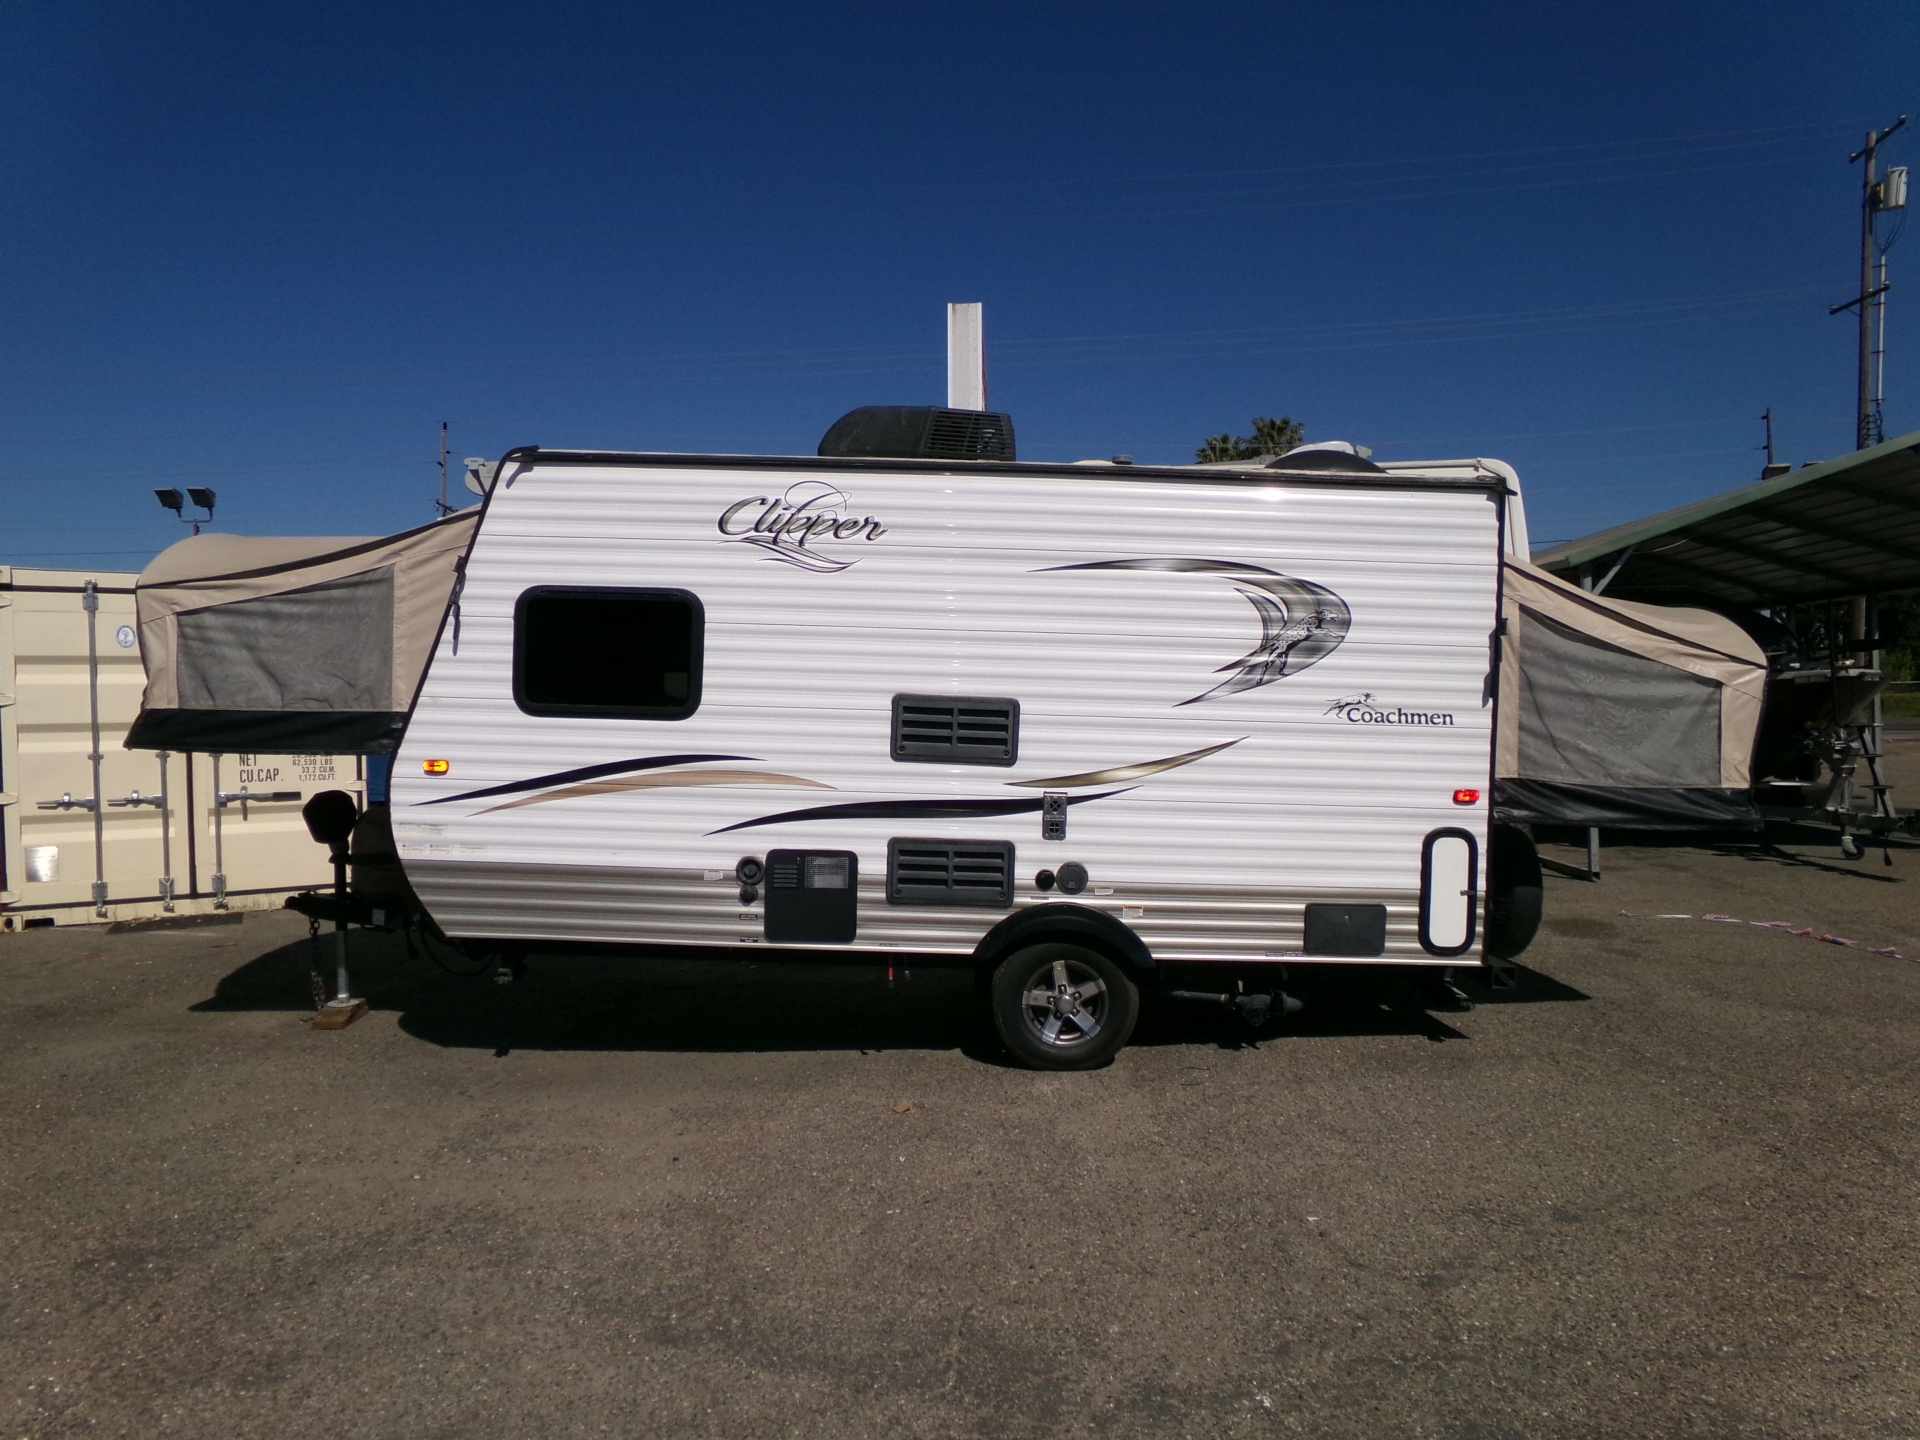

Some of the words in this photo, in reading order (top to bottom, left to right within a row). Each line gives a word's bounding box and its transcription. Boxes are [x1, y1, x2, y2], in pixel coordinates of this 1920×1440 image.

[717, 481, 889, 548] Clipper
[1346, 707, 1455, 726] Coachmen
[239, 754, 257, 767] NET
[292, 759, 317, 767] 62,530
[320, 758, 333, 766] LBS
[239, 768, 284, 783] CU.CAP.
[301, 766, 317, 774] 33.2
[298, 774, 317, 782] 1,172
